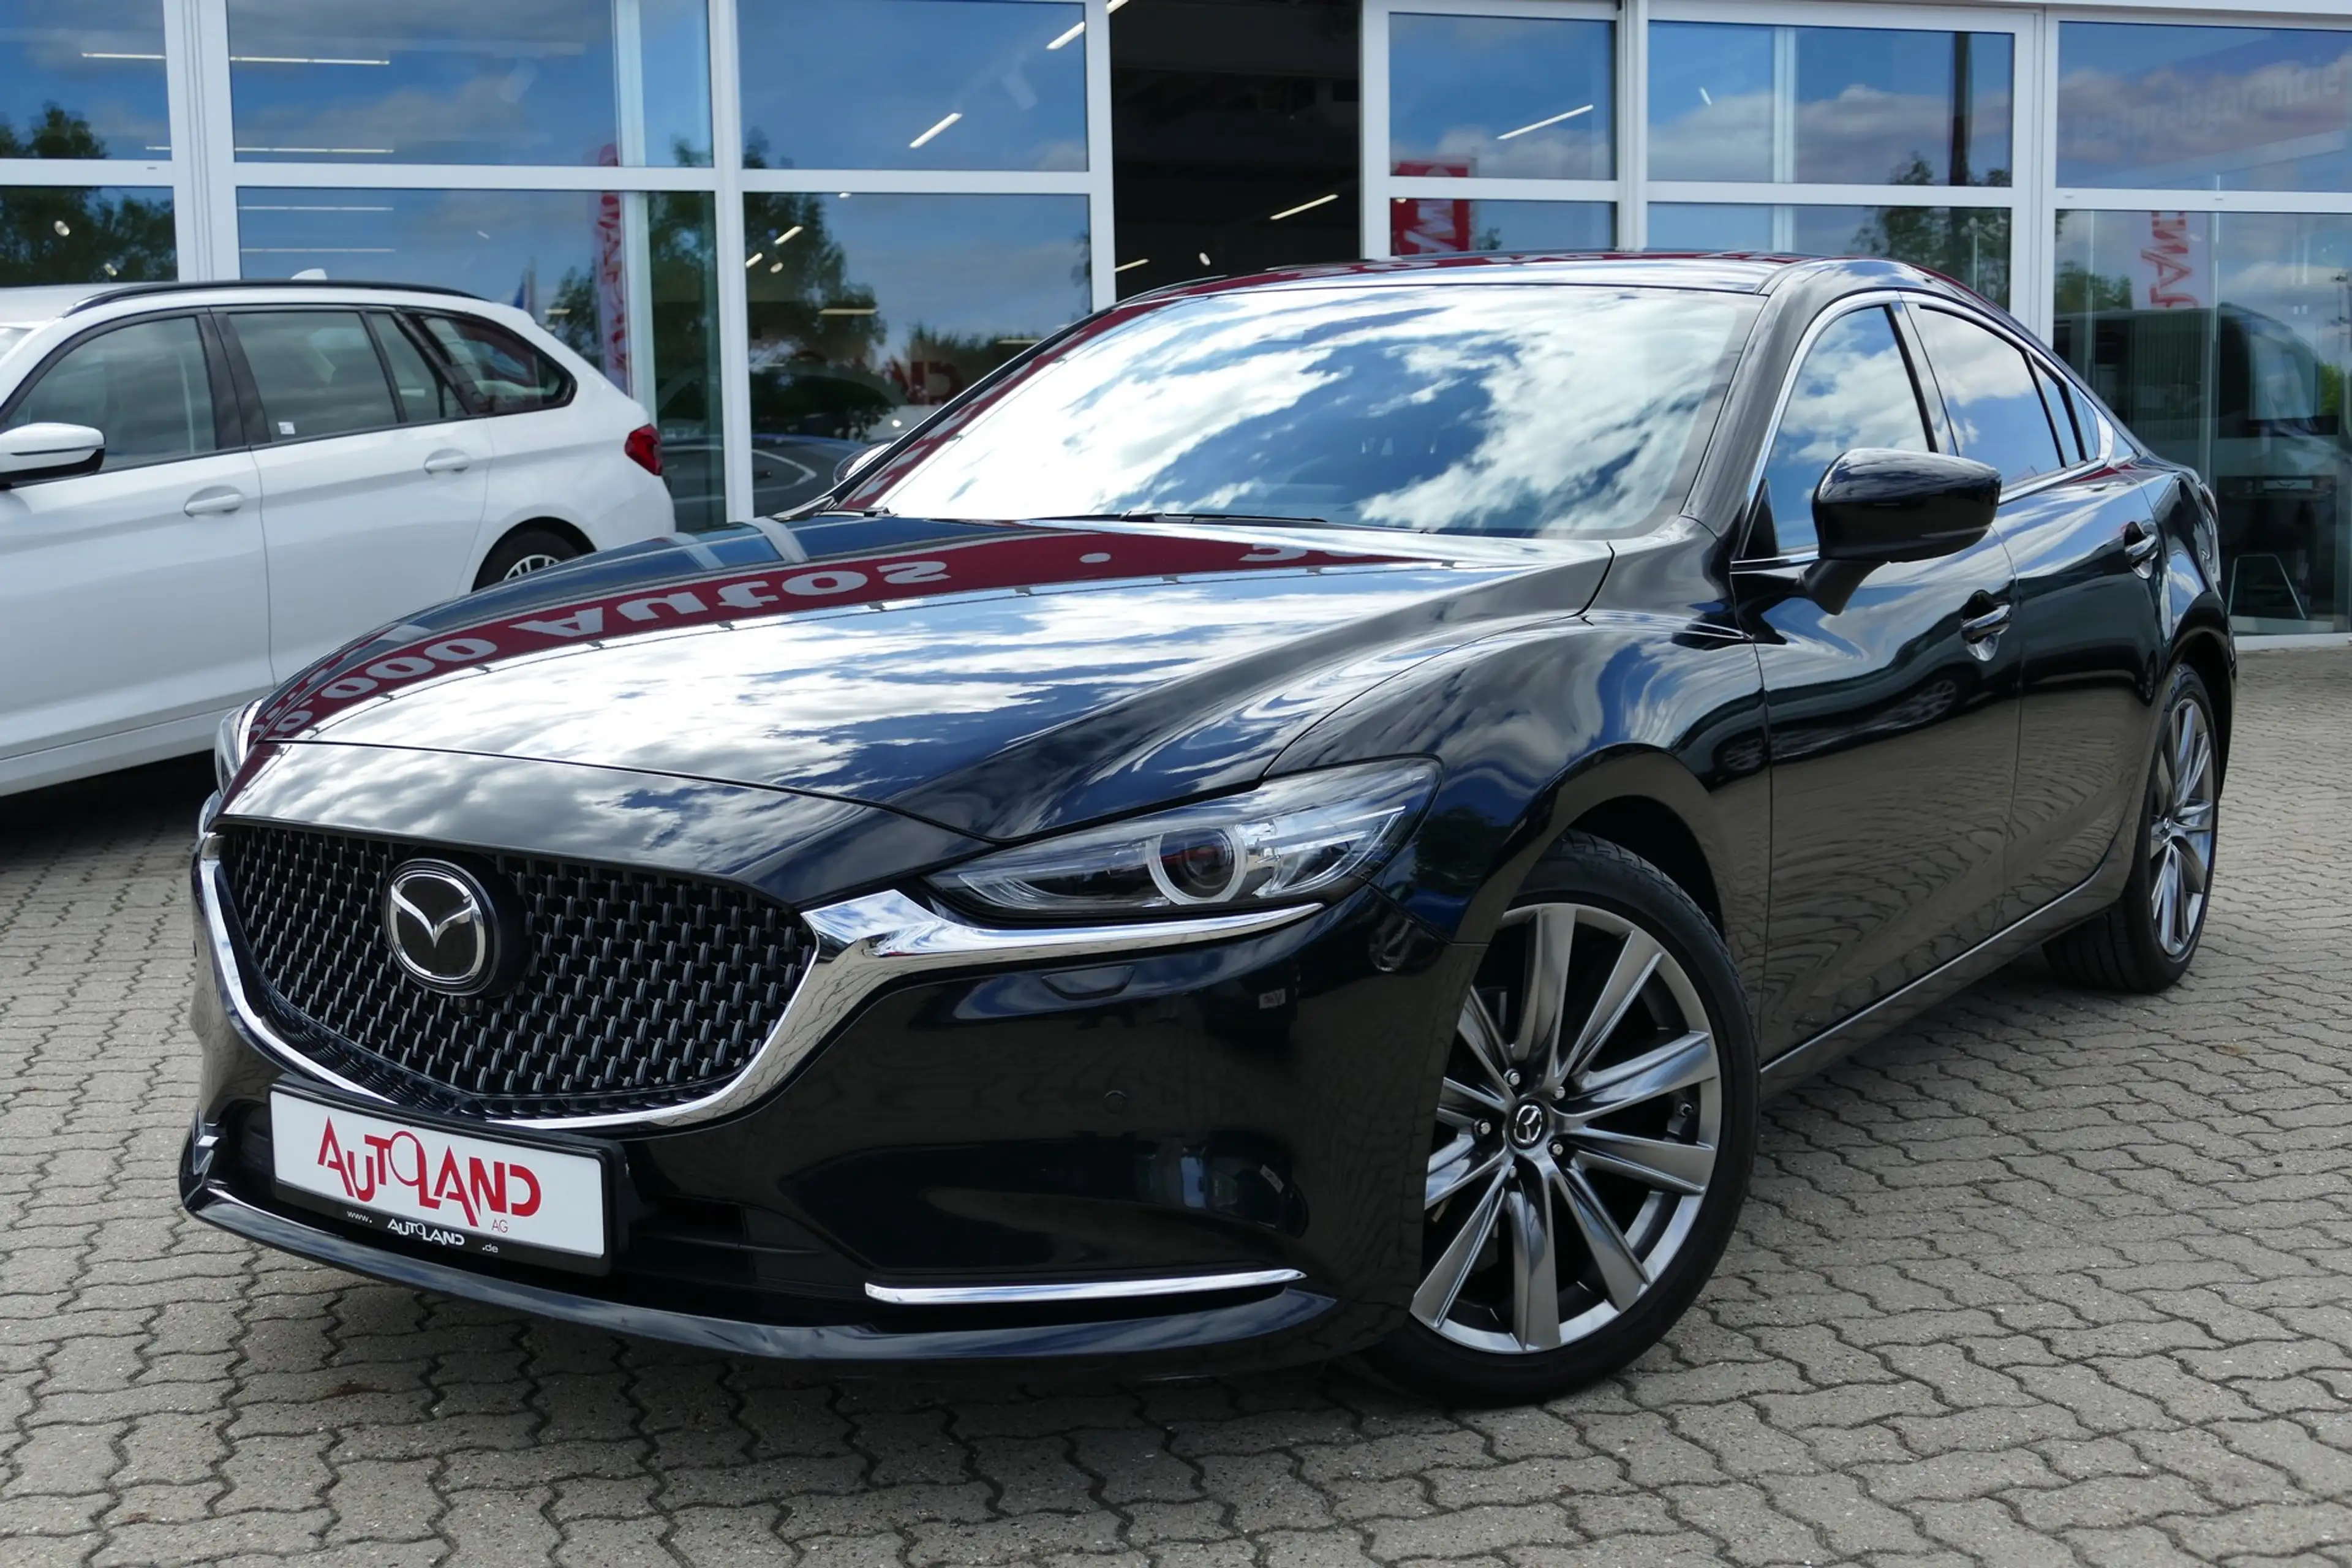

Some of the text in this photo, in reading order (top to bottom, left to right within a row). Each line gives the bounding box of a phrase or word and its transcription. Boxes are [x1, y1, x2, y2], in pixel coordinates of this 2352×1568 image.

[347, 1210, 372, 1223] www.
[482, 1243, 499, 1253] .de
[491, 1219, 508, 1234] AG
